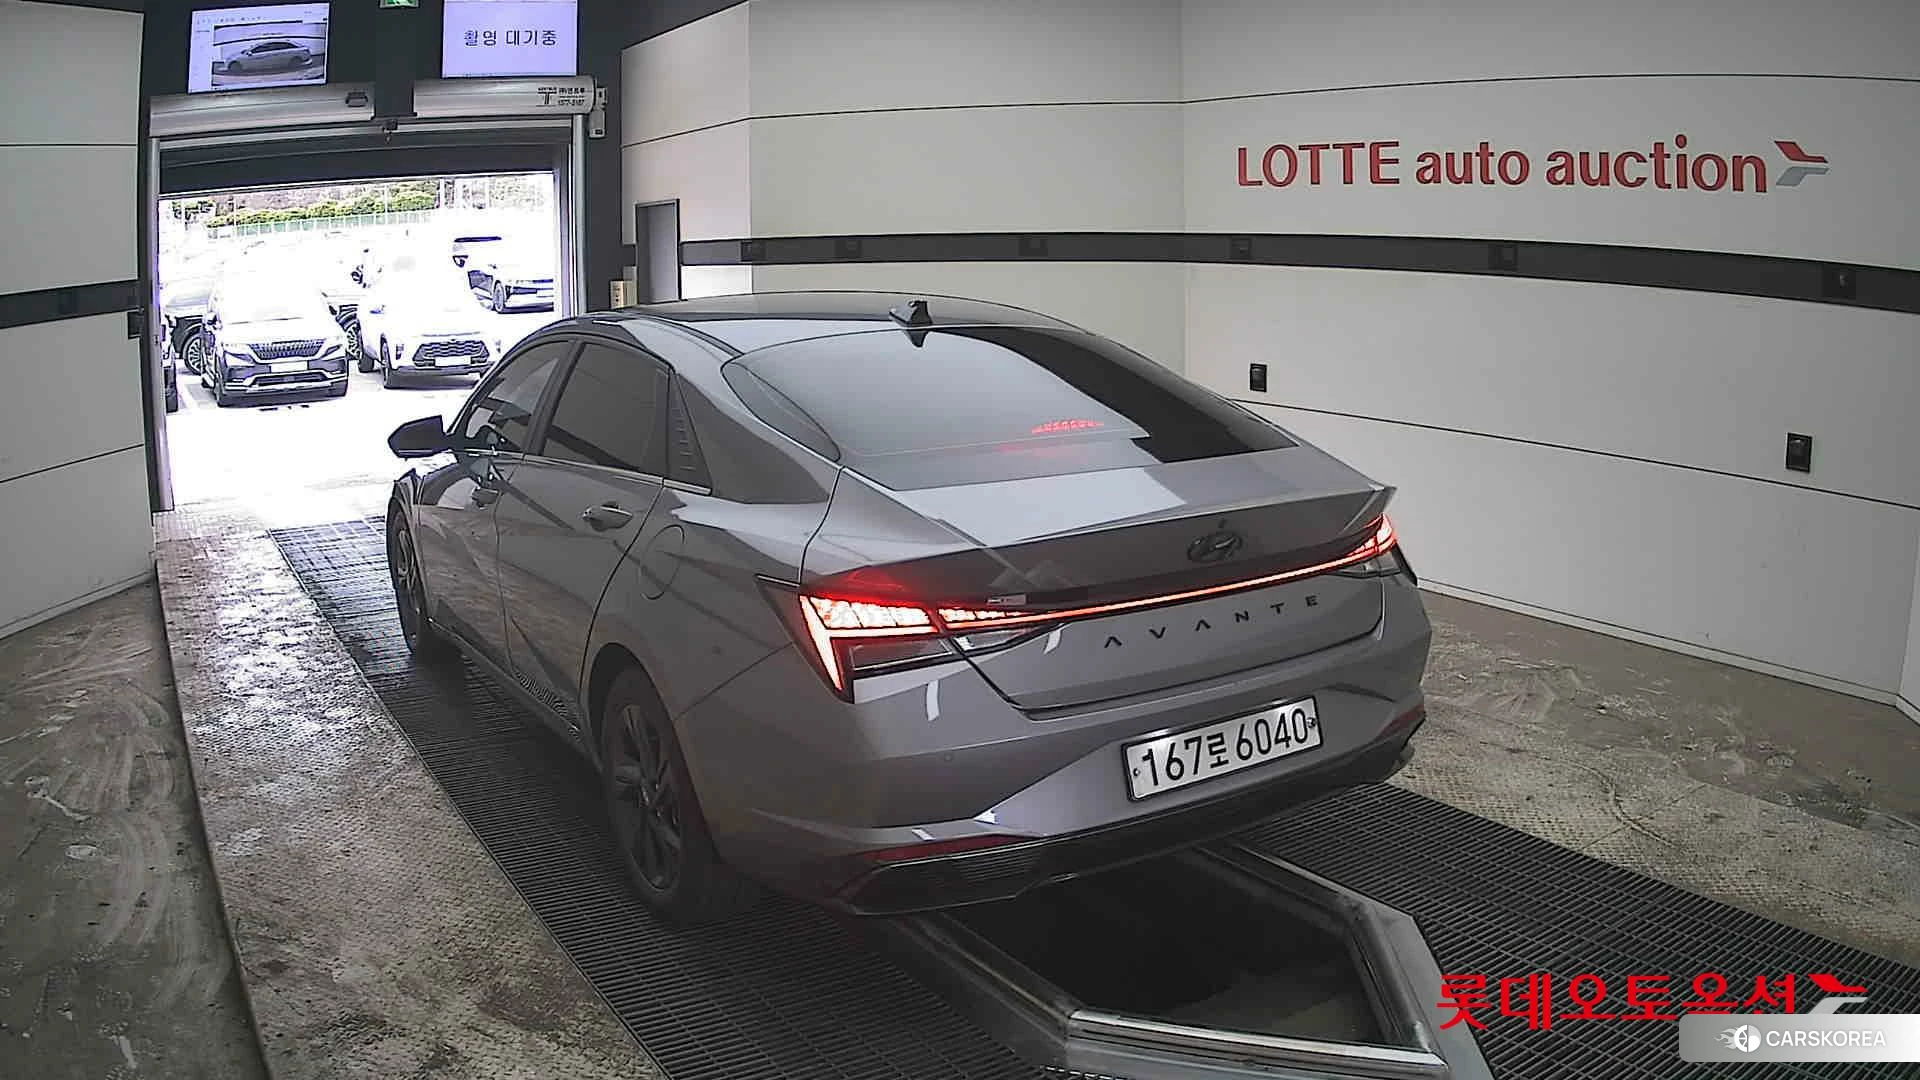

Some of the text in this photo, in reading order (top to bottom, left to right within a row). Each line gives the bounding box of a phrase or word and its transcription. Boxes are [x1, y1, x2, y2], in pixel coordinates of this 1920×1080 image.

[464, 30, 557, 47] 촬영 대기중
[1238, 134, 1767, 193] LOTTE auto auction
[1104, 595, 1318, 648] AVANTE
